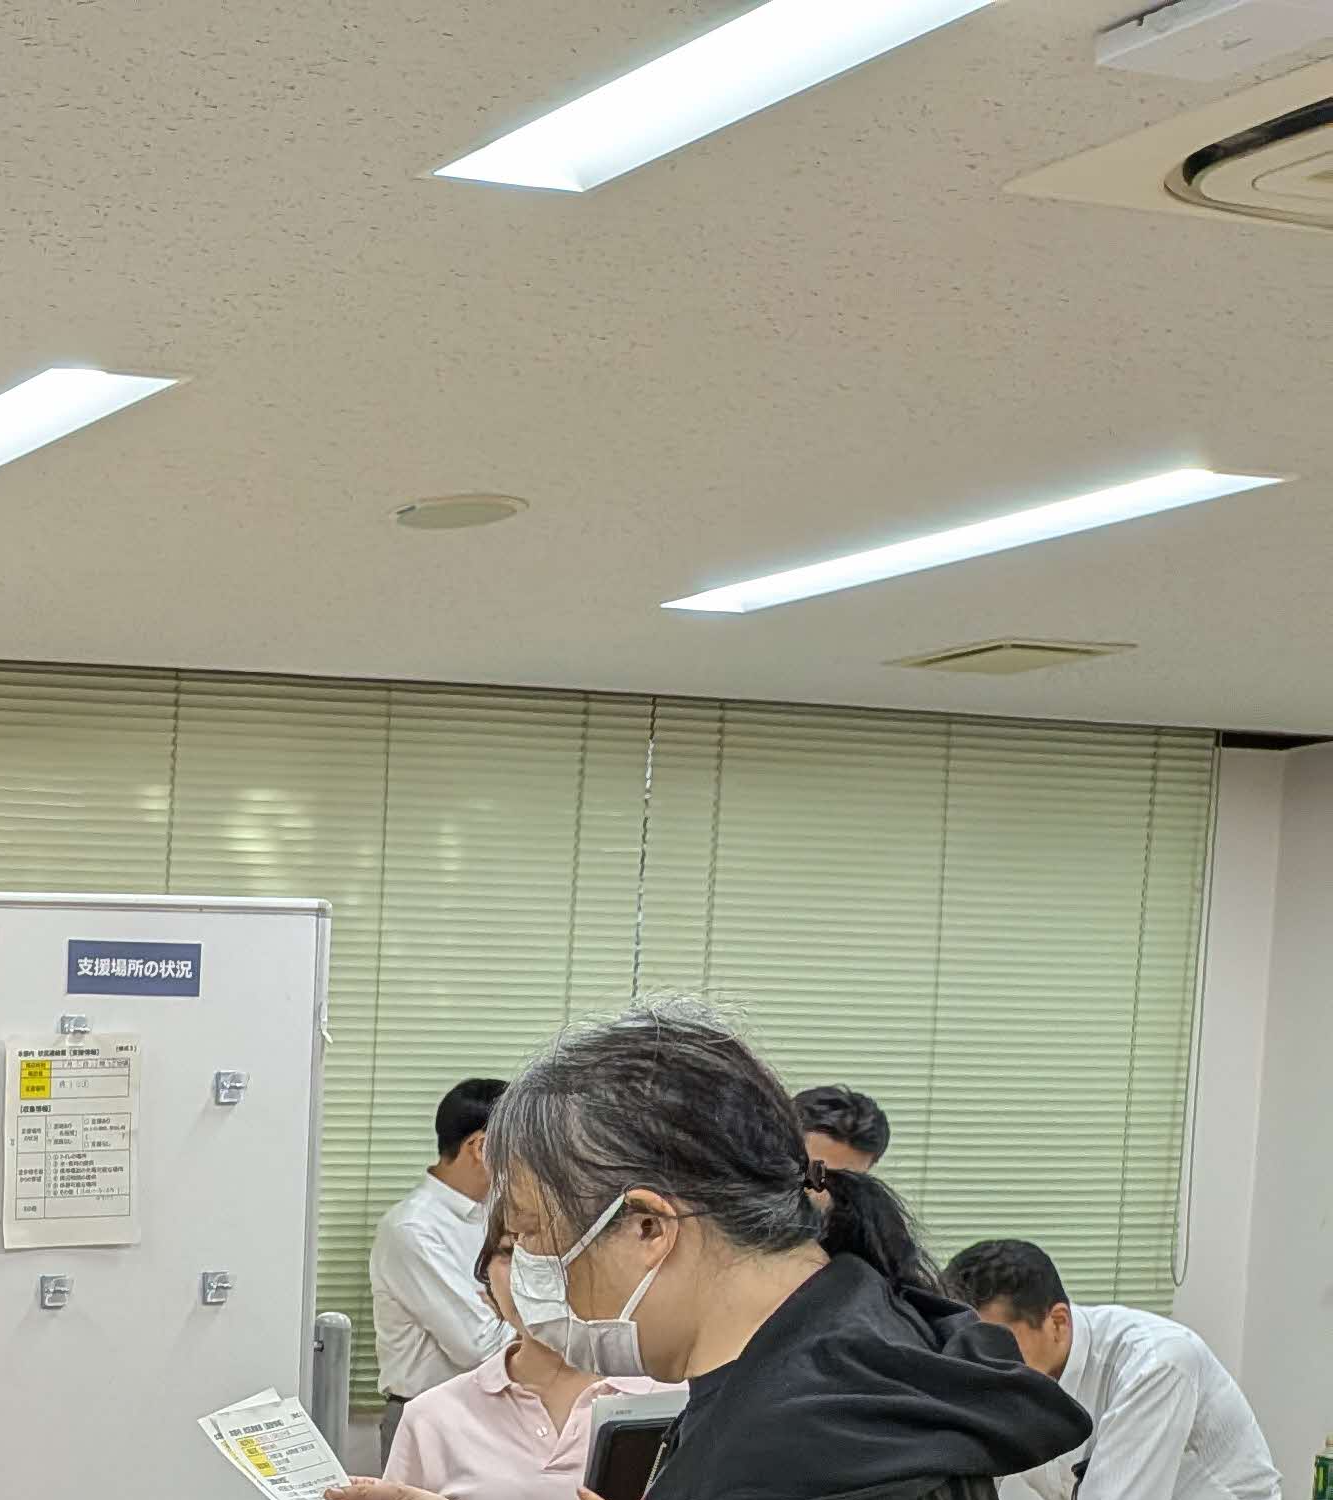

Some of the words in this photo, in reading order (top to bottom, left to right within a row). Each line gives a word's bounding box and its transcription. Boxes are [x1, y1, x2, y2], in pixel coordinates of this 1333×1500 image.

[76, 957, 193, 981] 支援場所の状況
